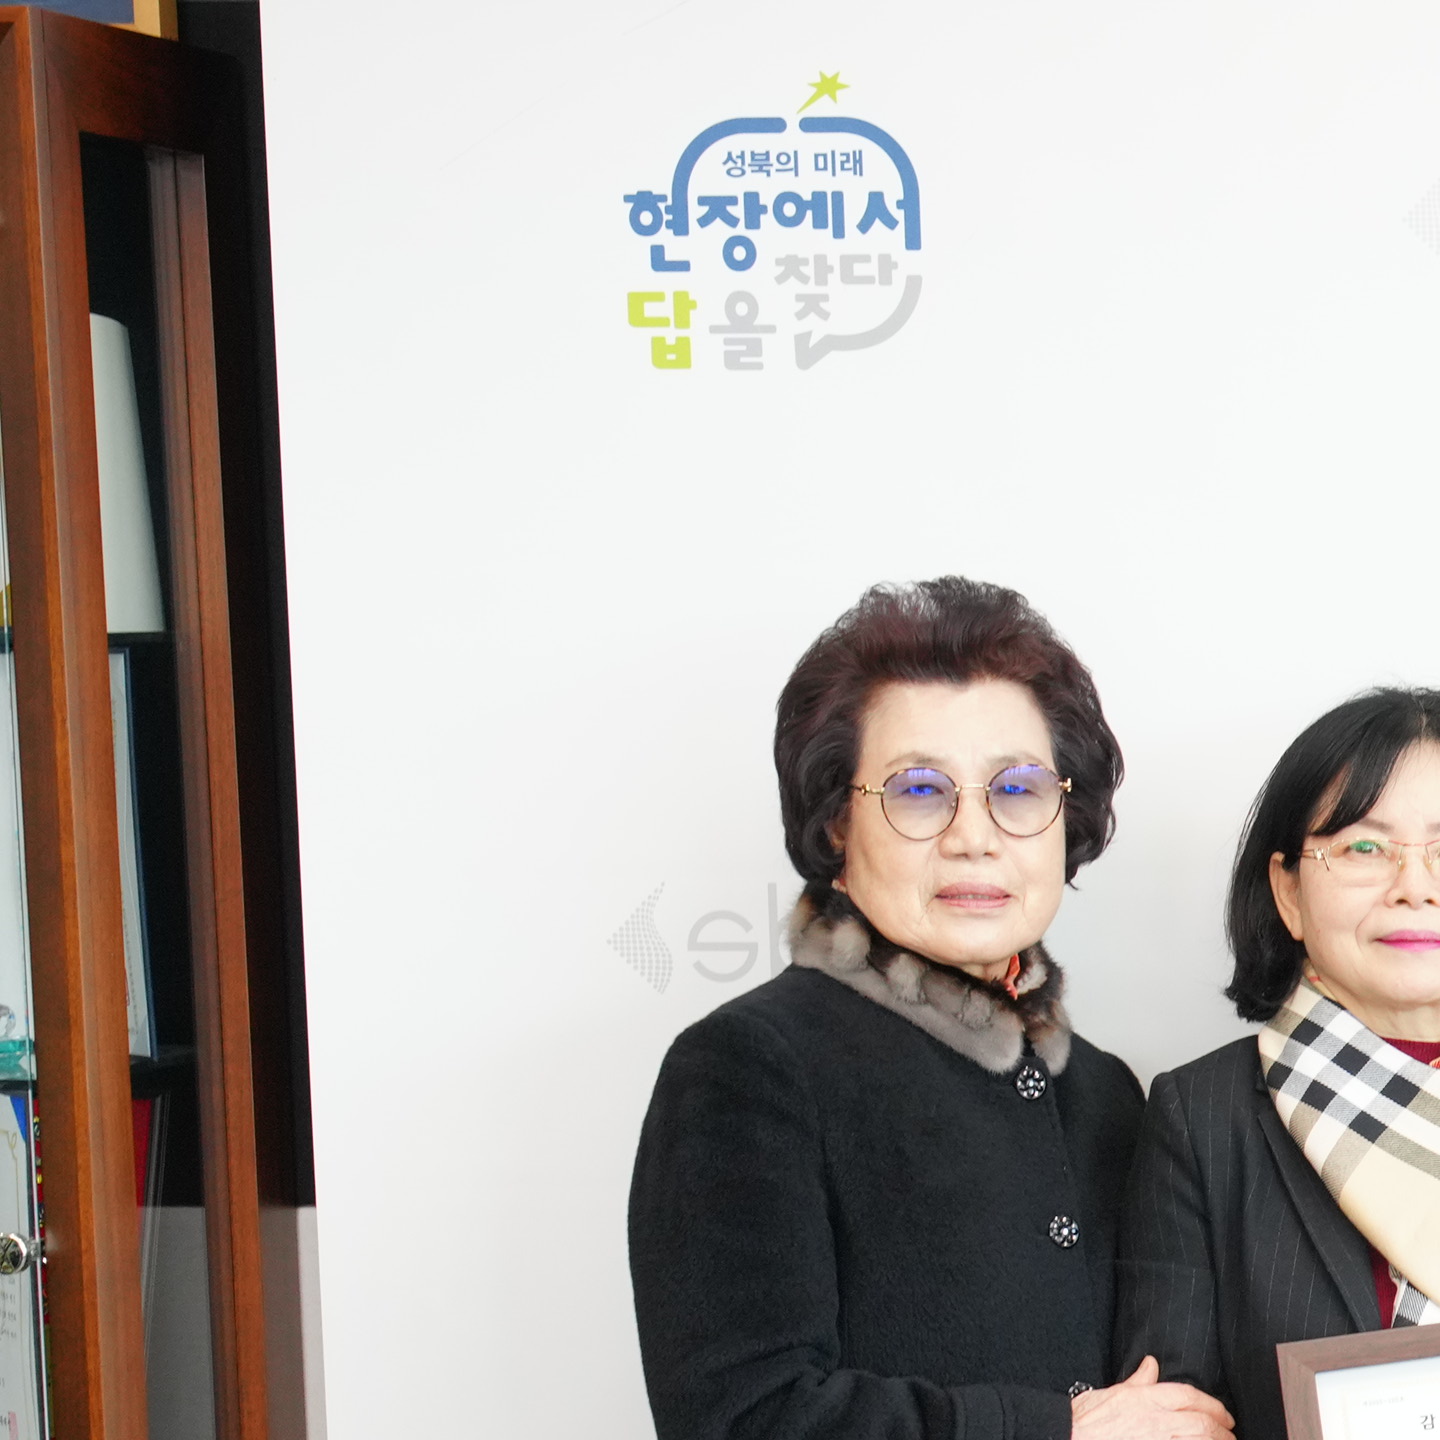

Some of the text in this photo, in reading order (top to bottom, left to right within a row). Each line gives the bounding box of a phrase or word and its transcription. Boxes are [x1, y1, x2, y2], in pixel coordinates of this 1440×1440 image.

[722, 150, 864, 177] 성북의 미래
[623, 190, 921, 272] 현장에서
[627, 254, 898, 370] 답을 찾다
[1420, 1413, 1436, 1431] 감
